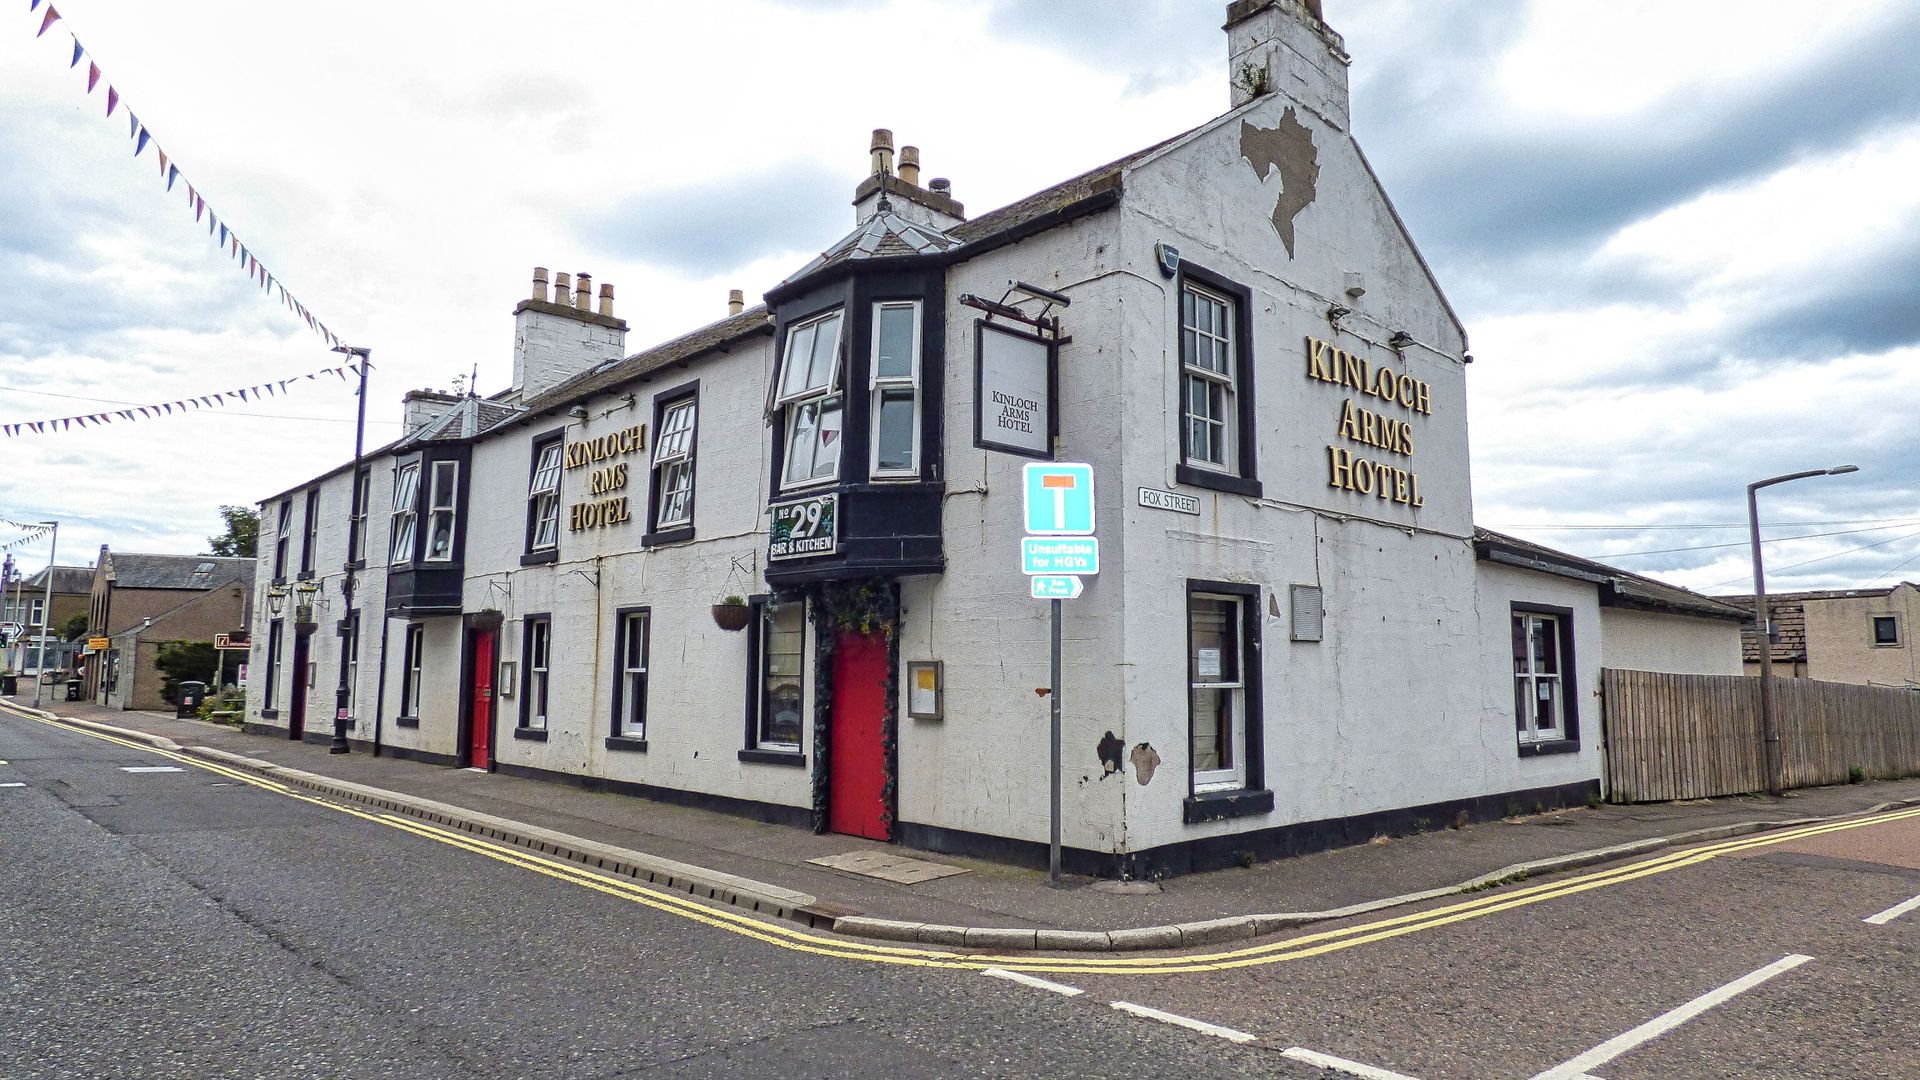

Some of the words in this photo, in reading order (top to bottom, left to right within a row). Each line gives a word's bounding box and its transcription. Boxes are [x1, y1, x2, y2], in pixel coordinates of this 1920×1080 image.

[1306, 336, 1432, 416] KINLOCH
[992, 391, 1038, 412] KINLOCH
[1001, 405, 1030, 421] ARMS
[998, 416, 1033, 433] HOTEL
[1339, 398, 1414, 456] ARMS
[565, 424, 645, 470] KINLOCH
[590, 462, 628, 495] RMS
[1327, 445, 1425, 508] HOTEL
[569, 497, 631, 531] HOTEL
[1143, 491, 1161, 506] FOX
[1164, 494, 1197, 511] STREET
[790, 502, 822, 538] 29
[771, 542, 787, 555] BAR
[788, 541, 795, 553] &
[796, 536, 832, 552] KITCHEN
[1028, 543, 1093, 555] Unsuitable
[1033, 556, 1050, 568] for
[1054, 556, 1088, 568] HGVs
